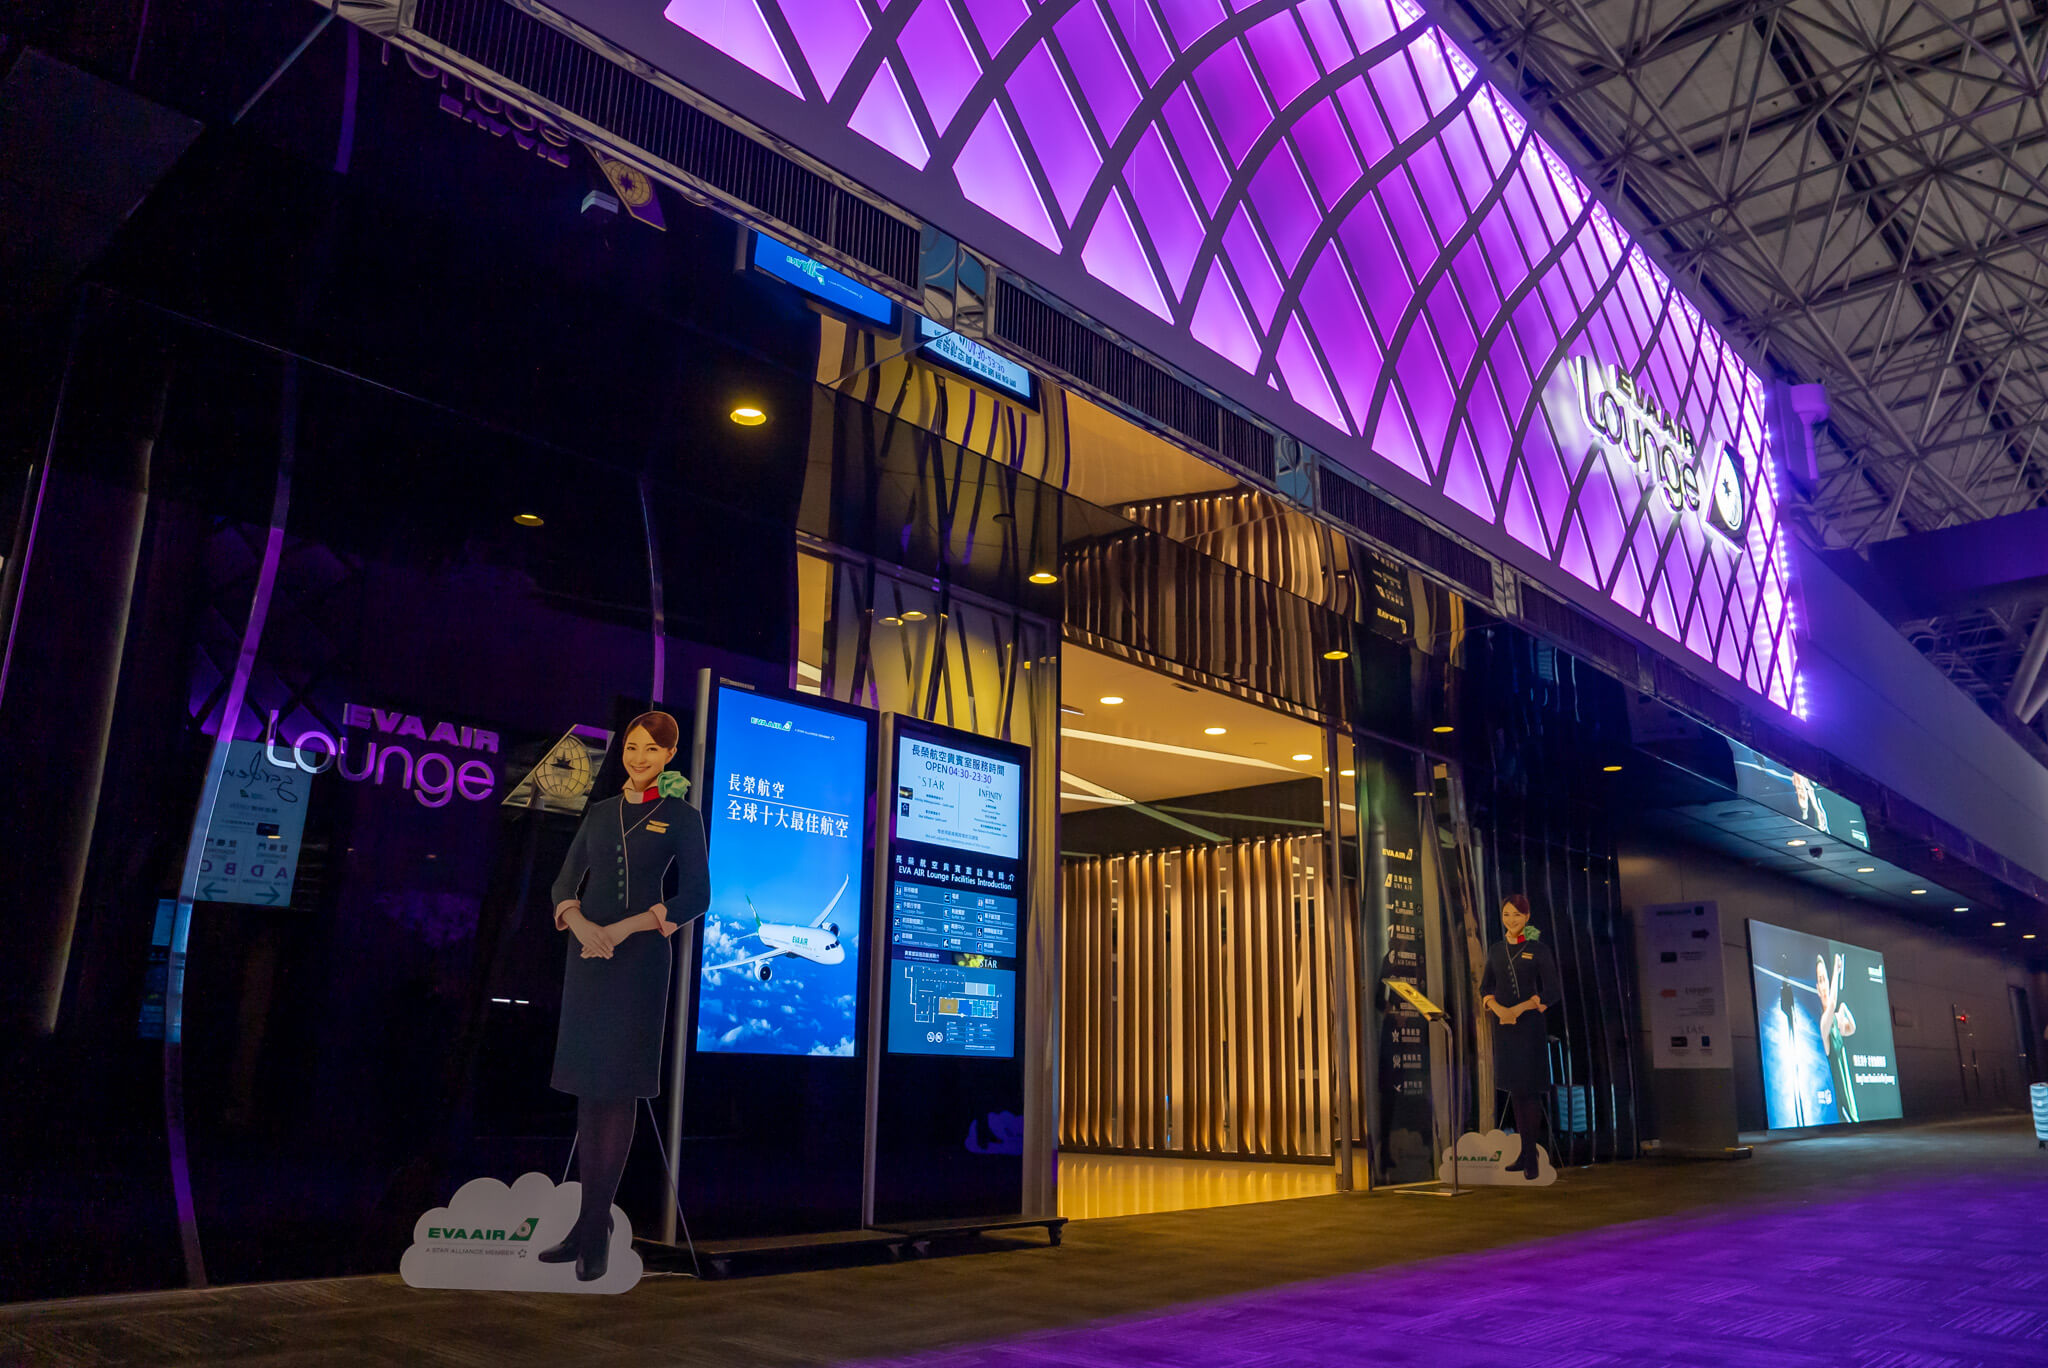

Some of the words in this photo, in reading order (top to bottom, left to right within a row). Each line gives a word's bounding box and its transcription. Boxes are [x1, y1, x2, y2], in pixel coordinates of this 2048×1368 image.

[1575, 355, 1700, 512] Lounge
[266, 709, 495, 808] Lounge
[912, 744, 1005, 777] 長榮航空貴賓室服務時間
[922, 777, 945, 791] STAR
[926, 761, 948, 775] OPEN
[949, 767, 992, 785] 04:30-23:30
[728, 773, 785, 800] 長榮航空
[978, 788, 1003, 802] INFINITY
[728, 800, 849, 838] 全球十大最佳航空
[899, 866, 912, 874] EVA
[914, 868, 925, 877] AIR
[927, 870, 950, 882] Lounge
[951, 874, 976, 886] Facilities
[977, 879, 1012, 892] Introduction
[980, 958, 998, 969] STAR
[451, 1248, 483, 1256] ALLIANCE
